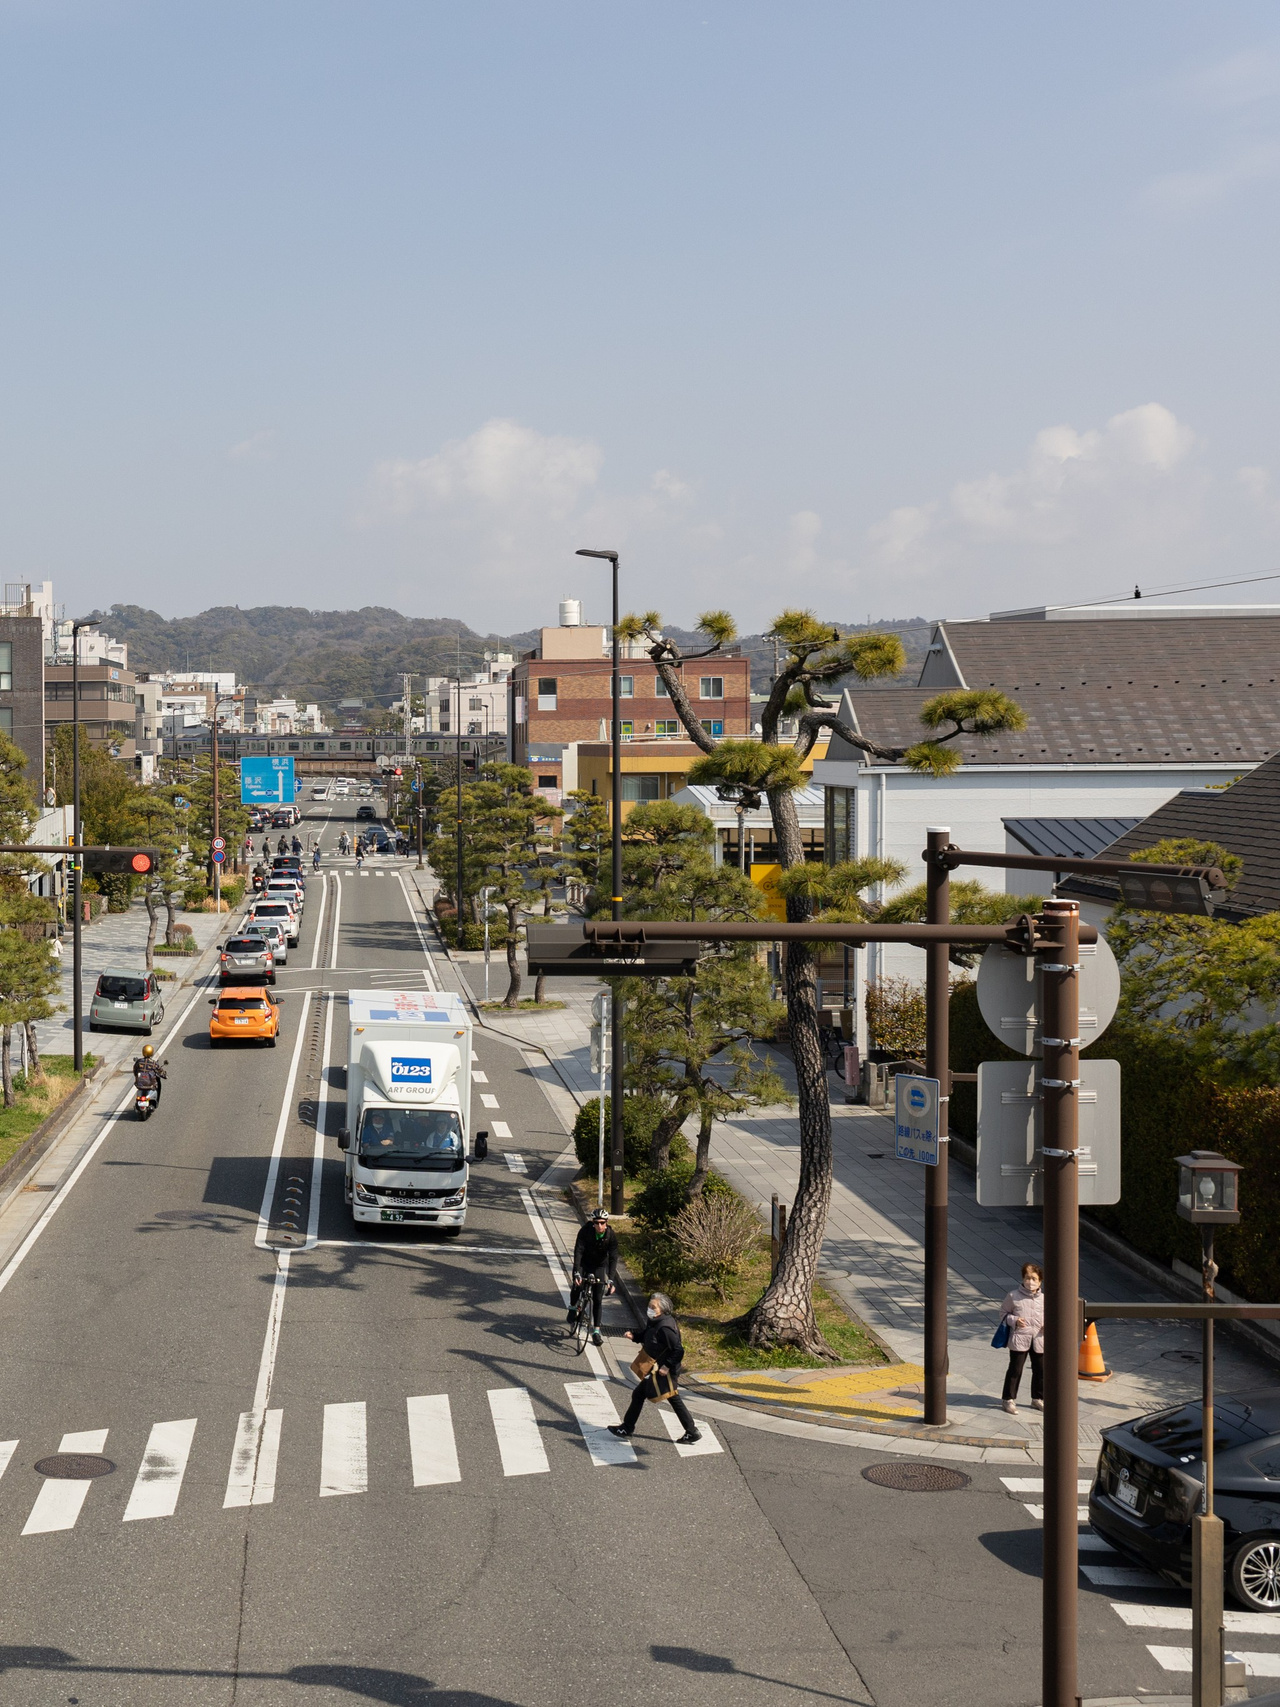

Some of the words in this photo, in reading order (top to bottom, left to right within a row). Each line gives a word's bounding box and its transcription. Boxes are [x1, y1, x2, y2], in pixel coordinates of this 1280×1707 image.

[392, 1065, 431, 1078] 0123
[898, 1124, 937, 1144] 路線バスを除く
[899, 1145, 916, 1160] この先
[918, 1149, 936, 1162] 100m
